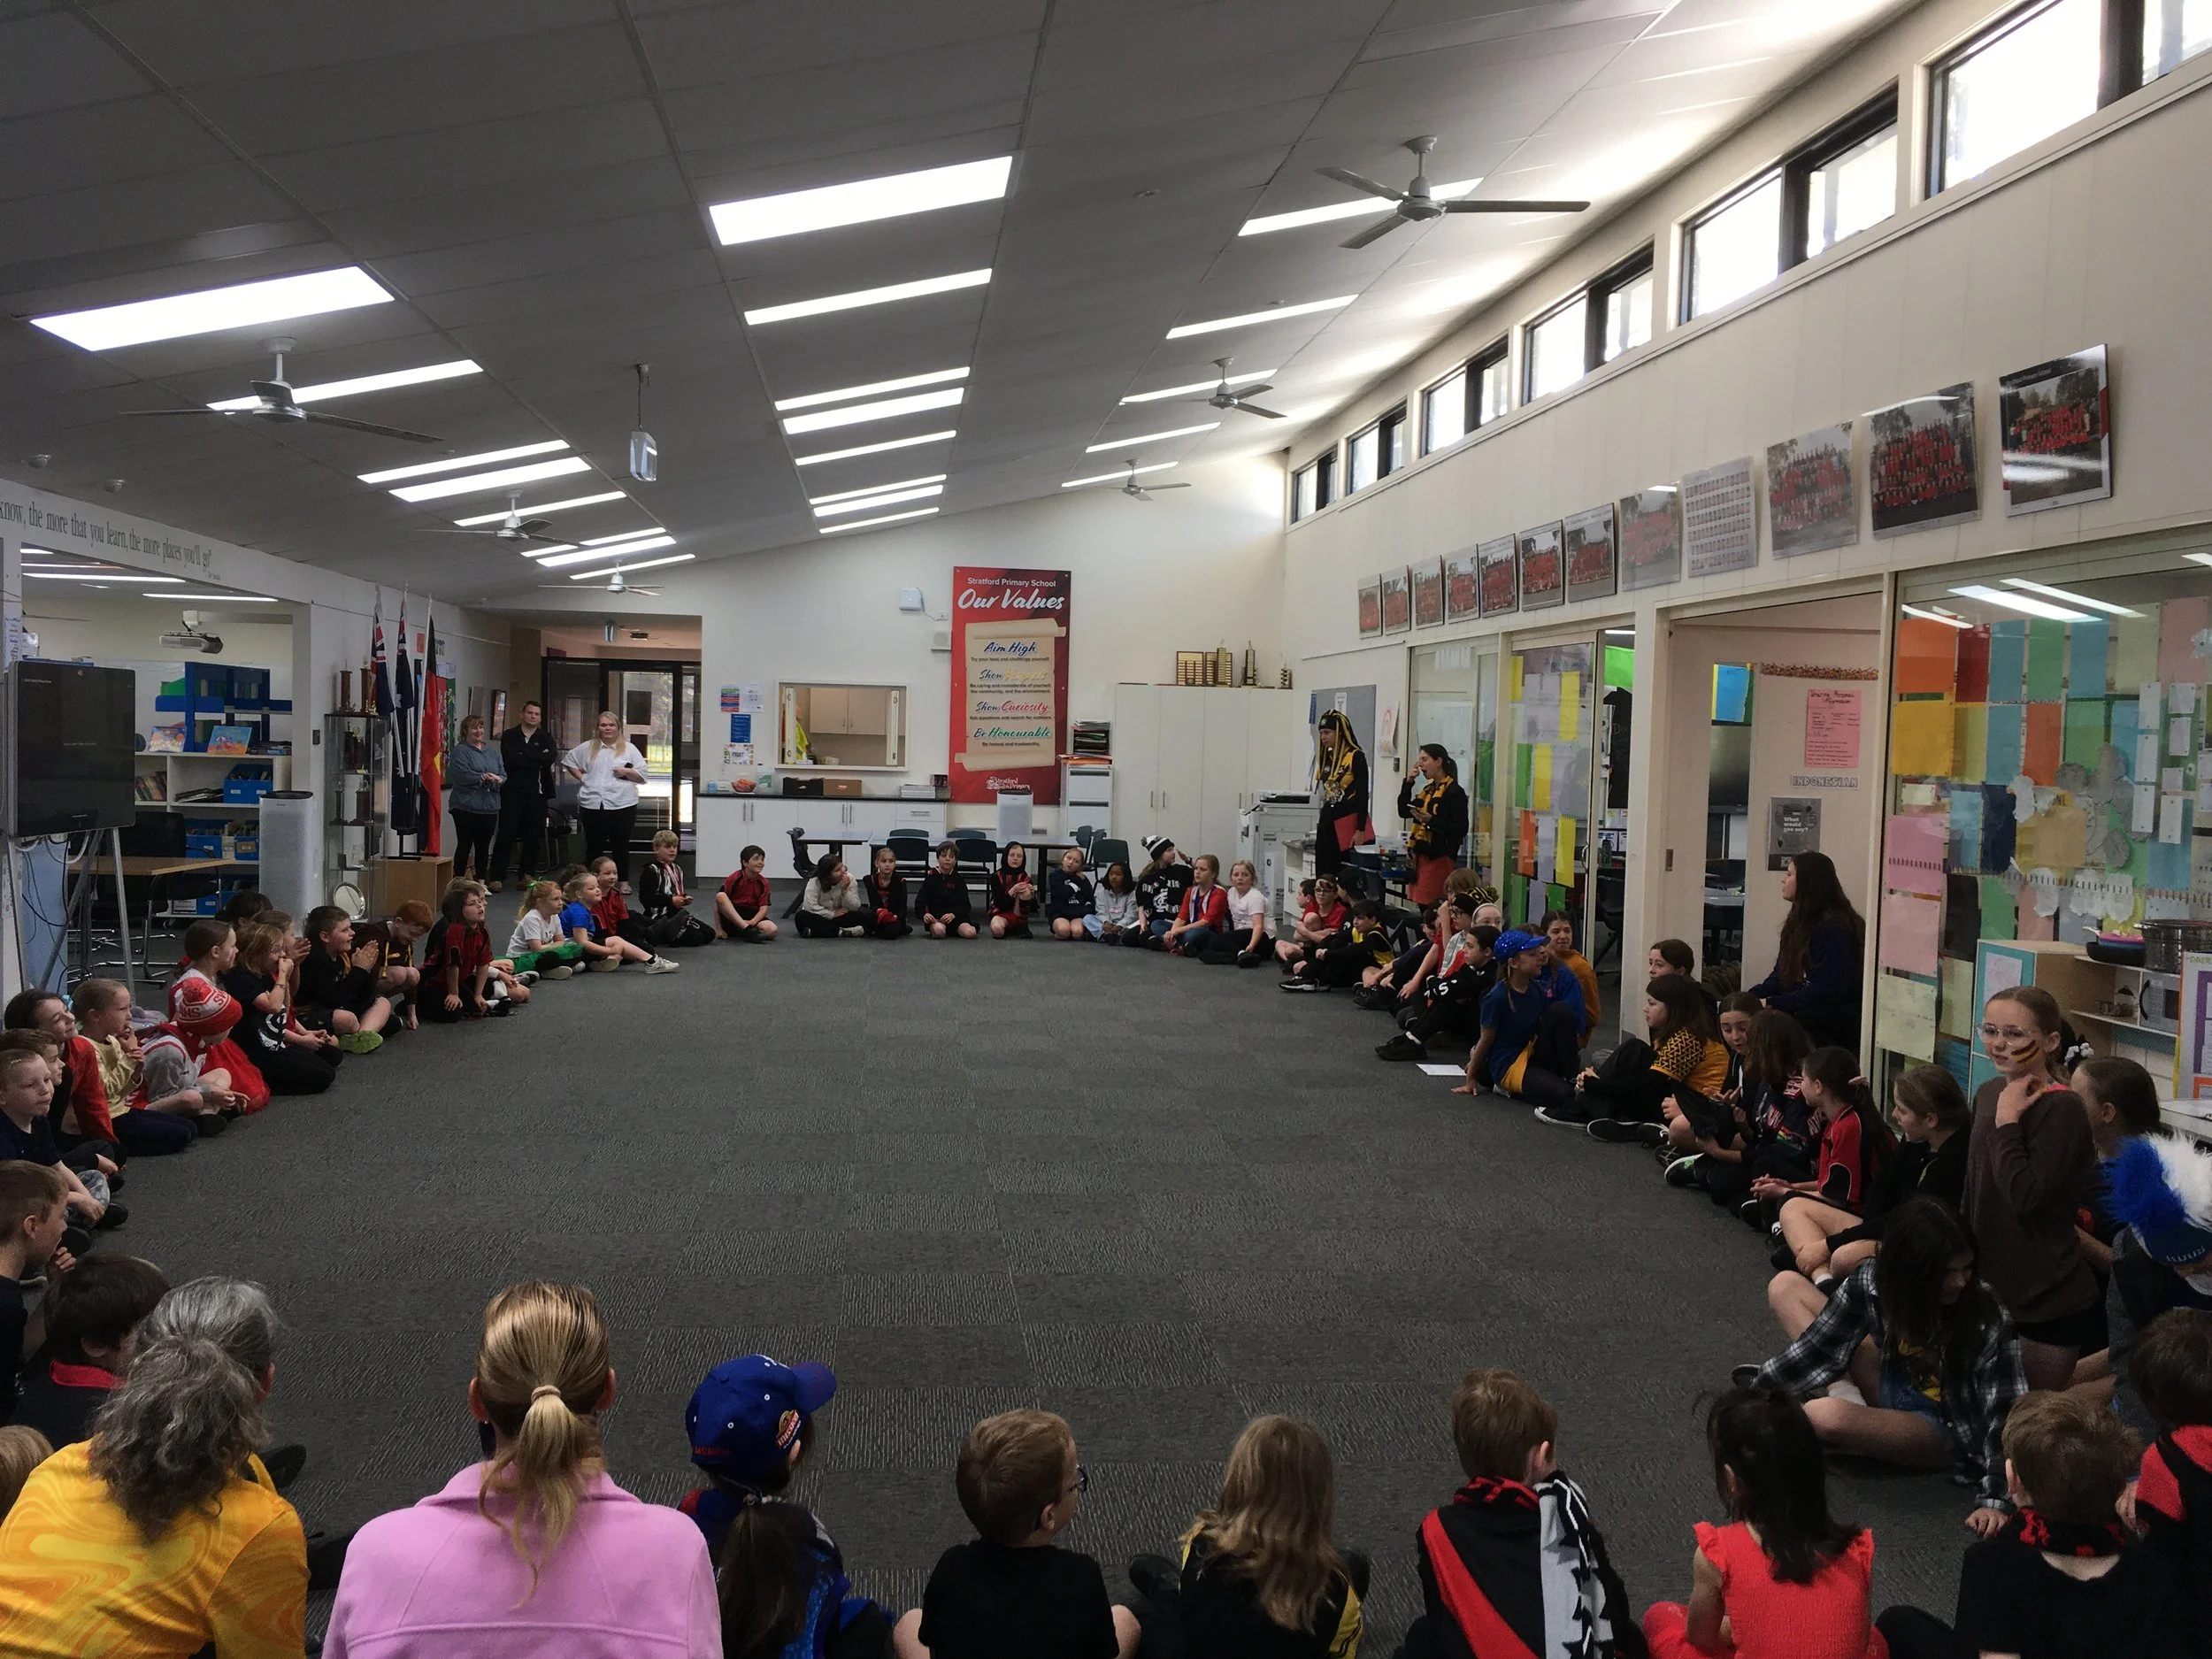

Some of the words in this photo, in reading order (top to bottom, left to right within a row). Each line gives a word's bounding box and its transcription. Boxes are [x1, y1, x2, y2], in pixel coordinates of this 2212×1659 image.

[29, 501, 42, 528] the
[46, 512, 68, 534] more
[71, 512, 87, 539] that
[90, 524, 104, 547] you
[106, 520, 128, 551] learn,
[129, 527, 141, 551] the
[143, 537, 160, 557] more
[162, 537, 182, 564] places
[183, 544, 201, 568] you'll
[967, 577, 1000, 586] Stratford
[1001, 578, 1030, 588] Primary
[957, 588, 1000, 609] Our
[1001, 588, 1065, 610] Values
[984, 641, 1006, 652] Aim
[1008, 641, 1037, 657] High
[979, 669, 1002, 680] Show
[975, 701, 998, 711] Show
[1001, 700, 1048, 715] Curiosity
[973, 727, 987, 738] Be
[987, 726, 1051, 738] Honourable
[1792, 776, 1858, 787] INDONESIAN
